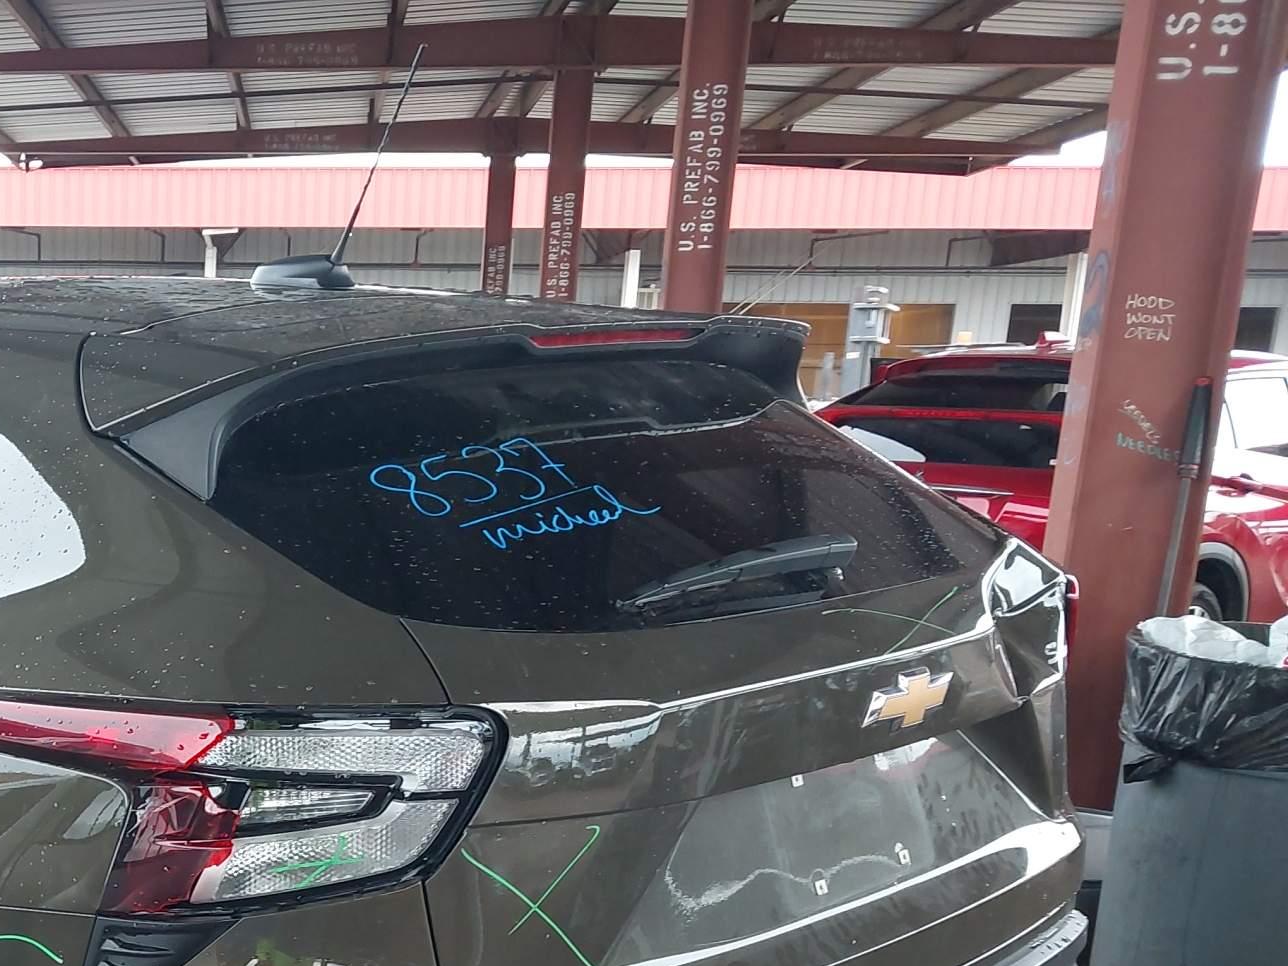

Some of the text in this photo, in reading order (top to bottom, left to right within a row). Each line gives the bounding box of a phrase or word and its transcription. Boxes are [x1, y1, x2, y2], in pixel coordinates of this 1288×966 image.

[1202, 0, 1248, 76] 1-8
[677, 82, 711, 251] U.S. PREFAB INC.
[697, 83, 729, 249] 1-866-799-0969
[1124, 325, 1173, 342] OPEN
[1126, 311, 1177, 325] WONT
[369, 437, 579, 517] 8537
